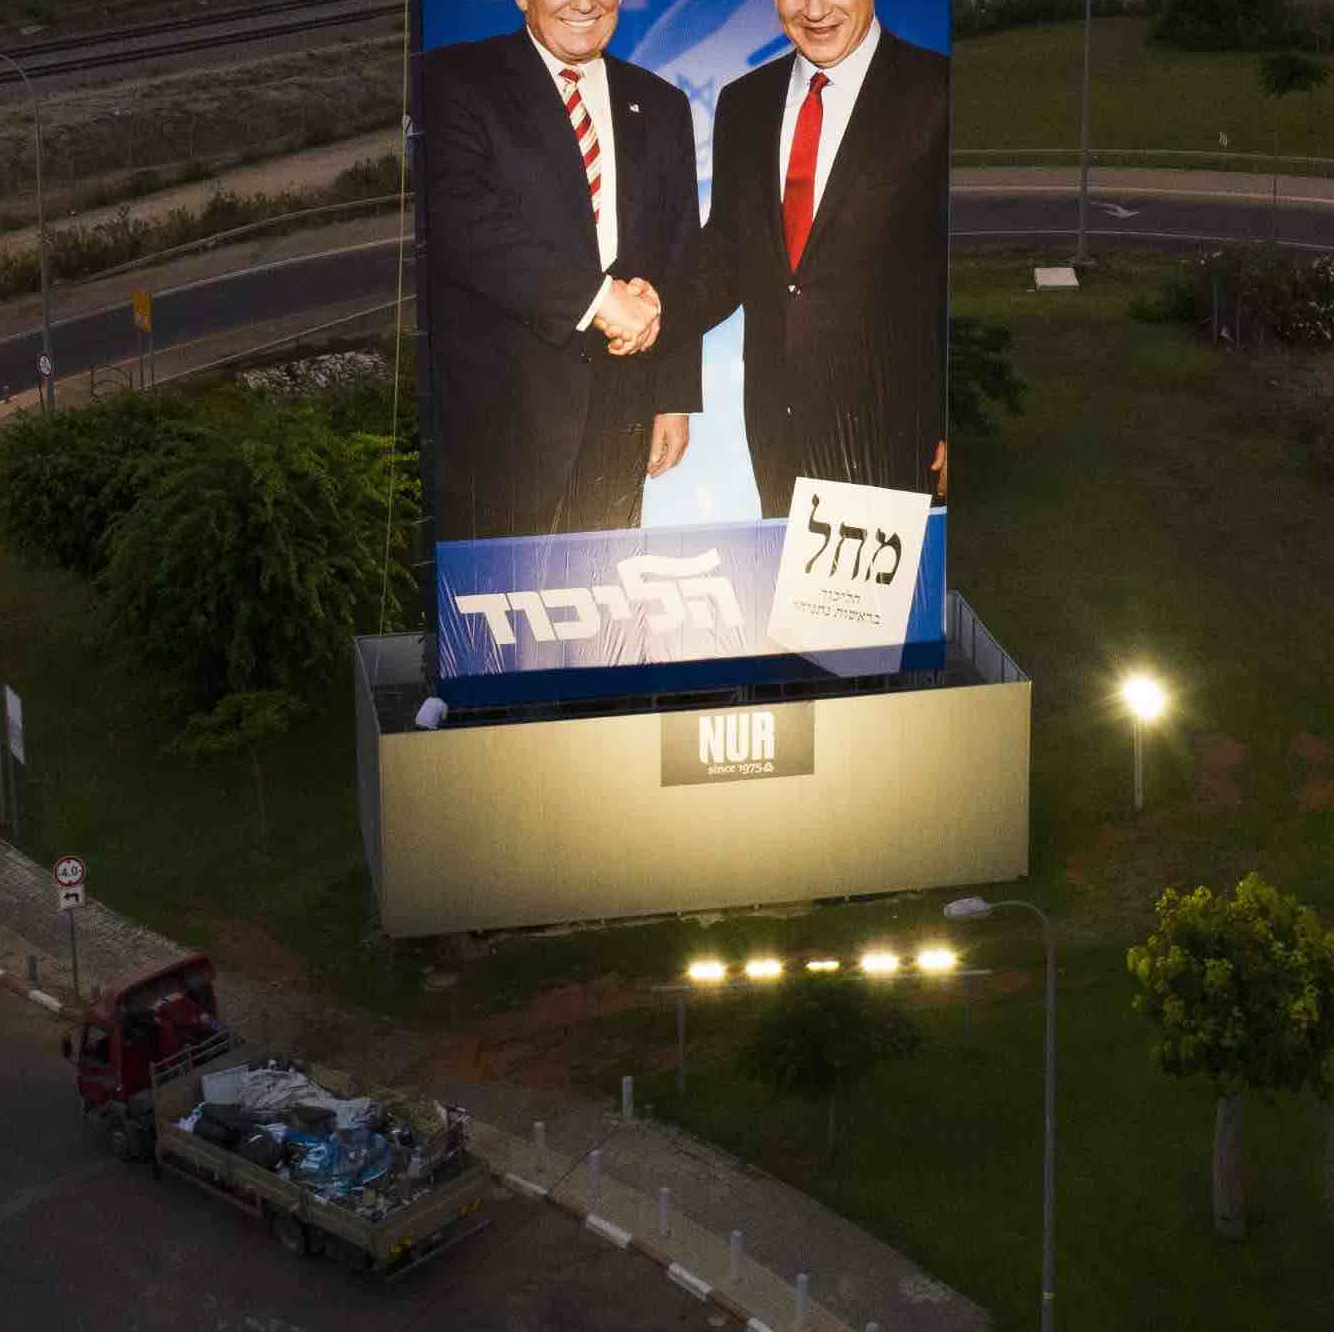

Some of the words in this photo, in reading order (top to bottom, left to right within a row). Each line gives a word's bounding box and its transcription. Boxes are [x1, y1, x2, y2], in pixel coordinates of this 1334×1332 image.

[805, 493, 903, 586] מחל
[455, 548, 746, 645] הליכוד
[699, 711, 776, 764] NUR
[707, 764, 736, 774] since
[738, 763, 764, 774] 1975
